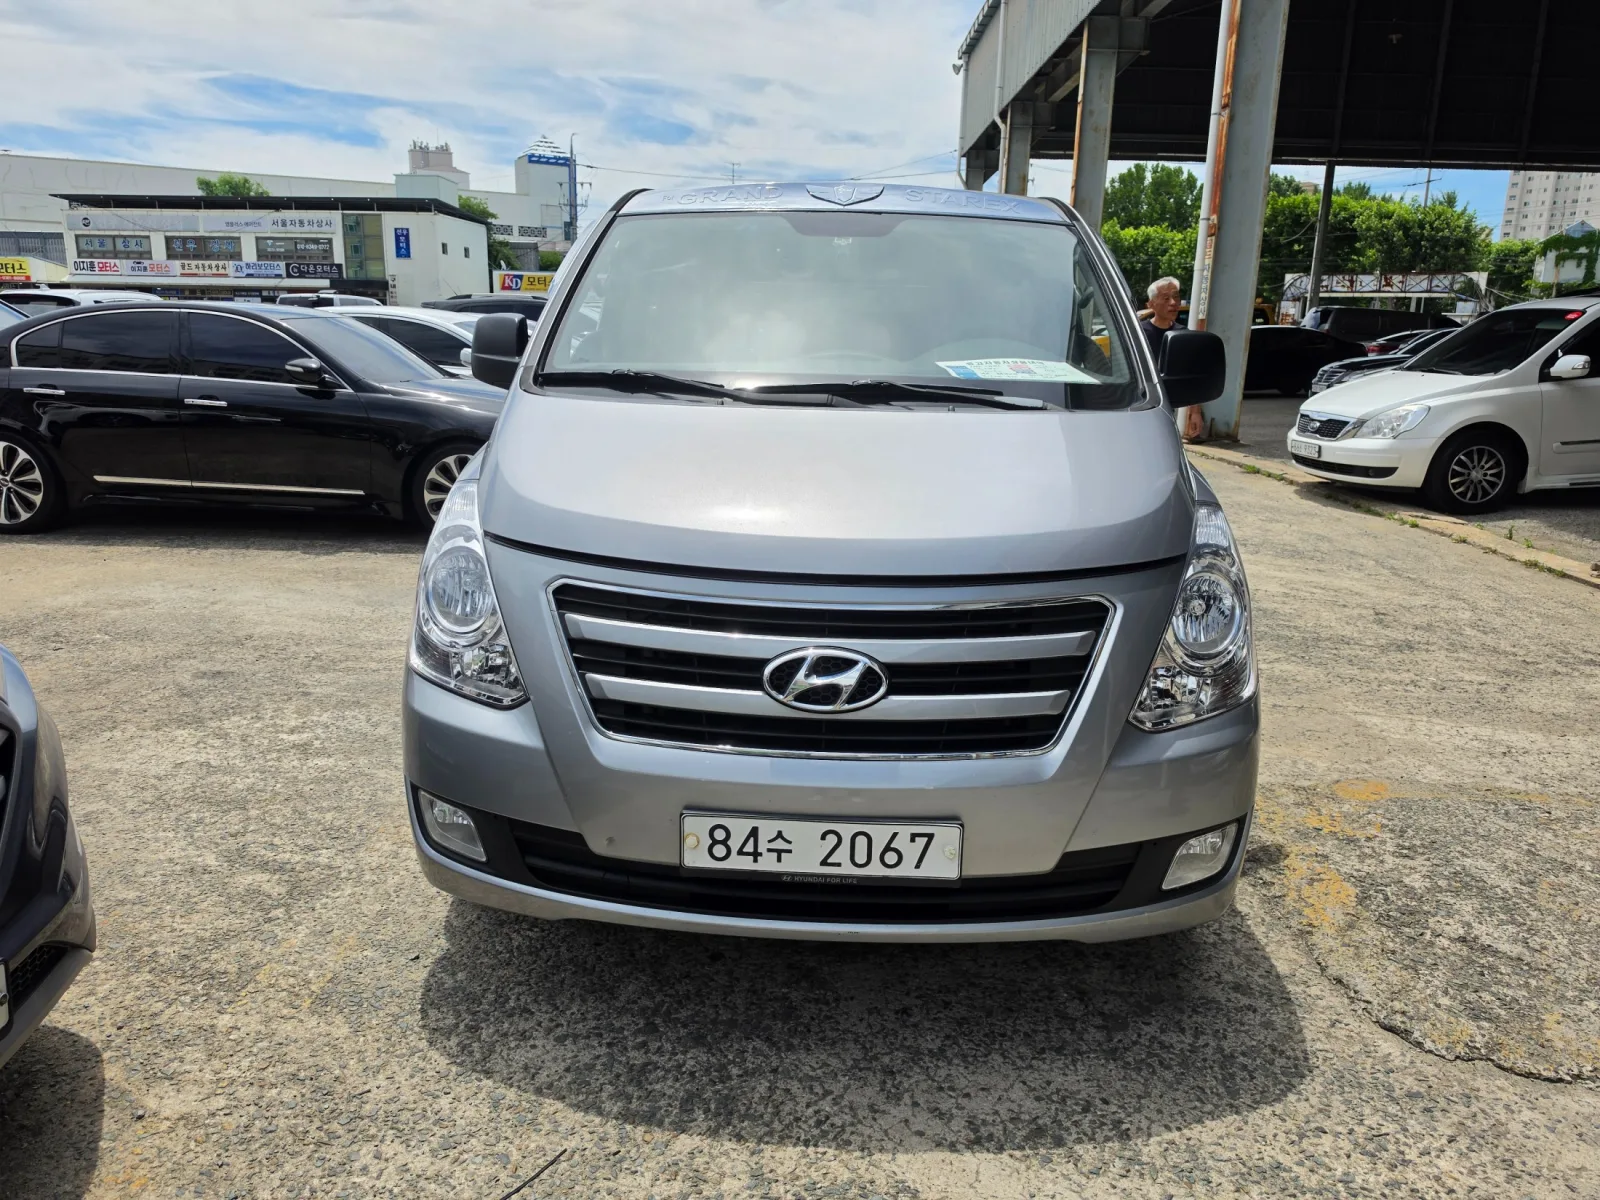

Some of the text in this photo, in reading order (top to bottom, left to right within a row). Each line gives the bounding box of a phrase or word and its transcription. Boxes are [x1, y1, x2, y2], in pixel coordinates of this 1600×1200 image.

[677, 186, 784, 205] GRAND
[905, 188, 1021, 214] STAREX
[271, 218, 333, 228] 서울자동차상사
[85, 237, 143, 248] 서울 상사
[73, 260, 120, 273] 이지훈 모터스
[148, 263, 171, 273] 모터스
[194, 263, 227, 272] 자동차상사
[300, 264, 339, 273] 다온모터스
[504, 275, 521, 290] KD
[707, 823, 935, 870] 84수 2067
